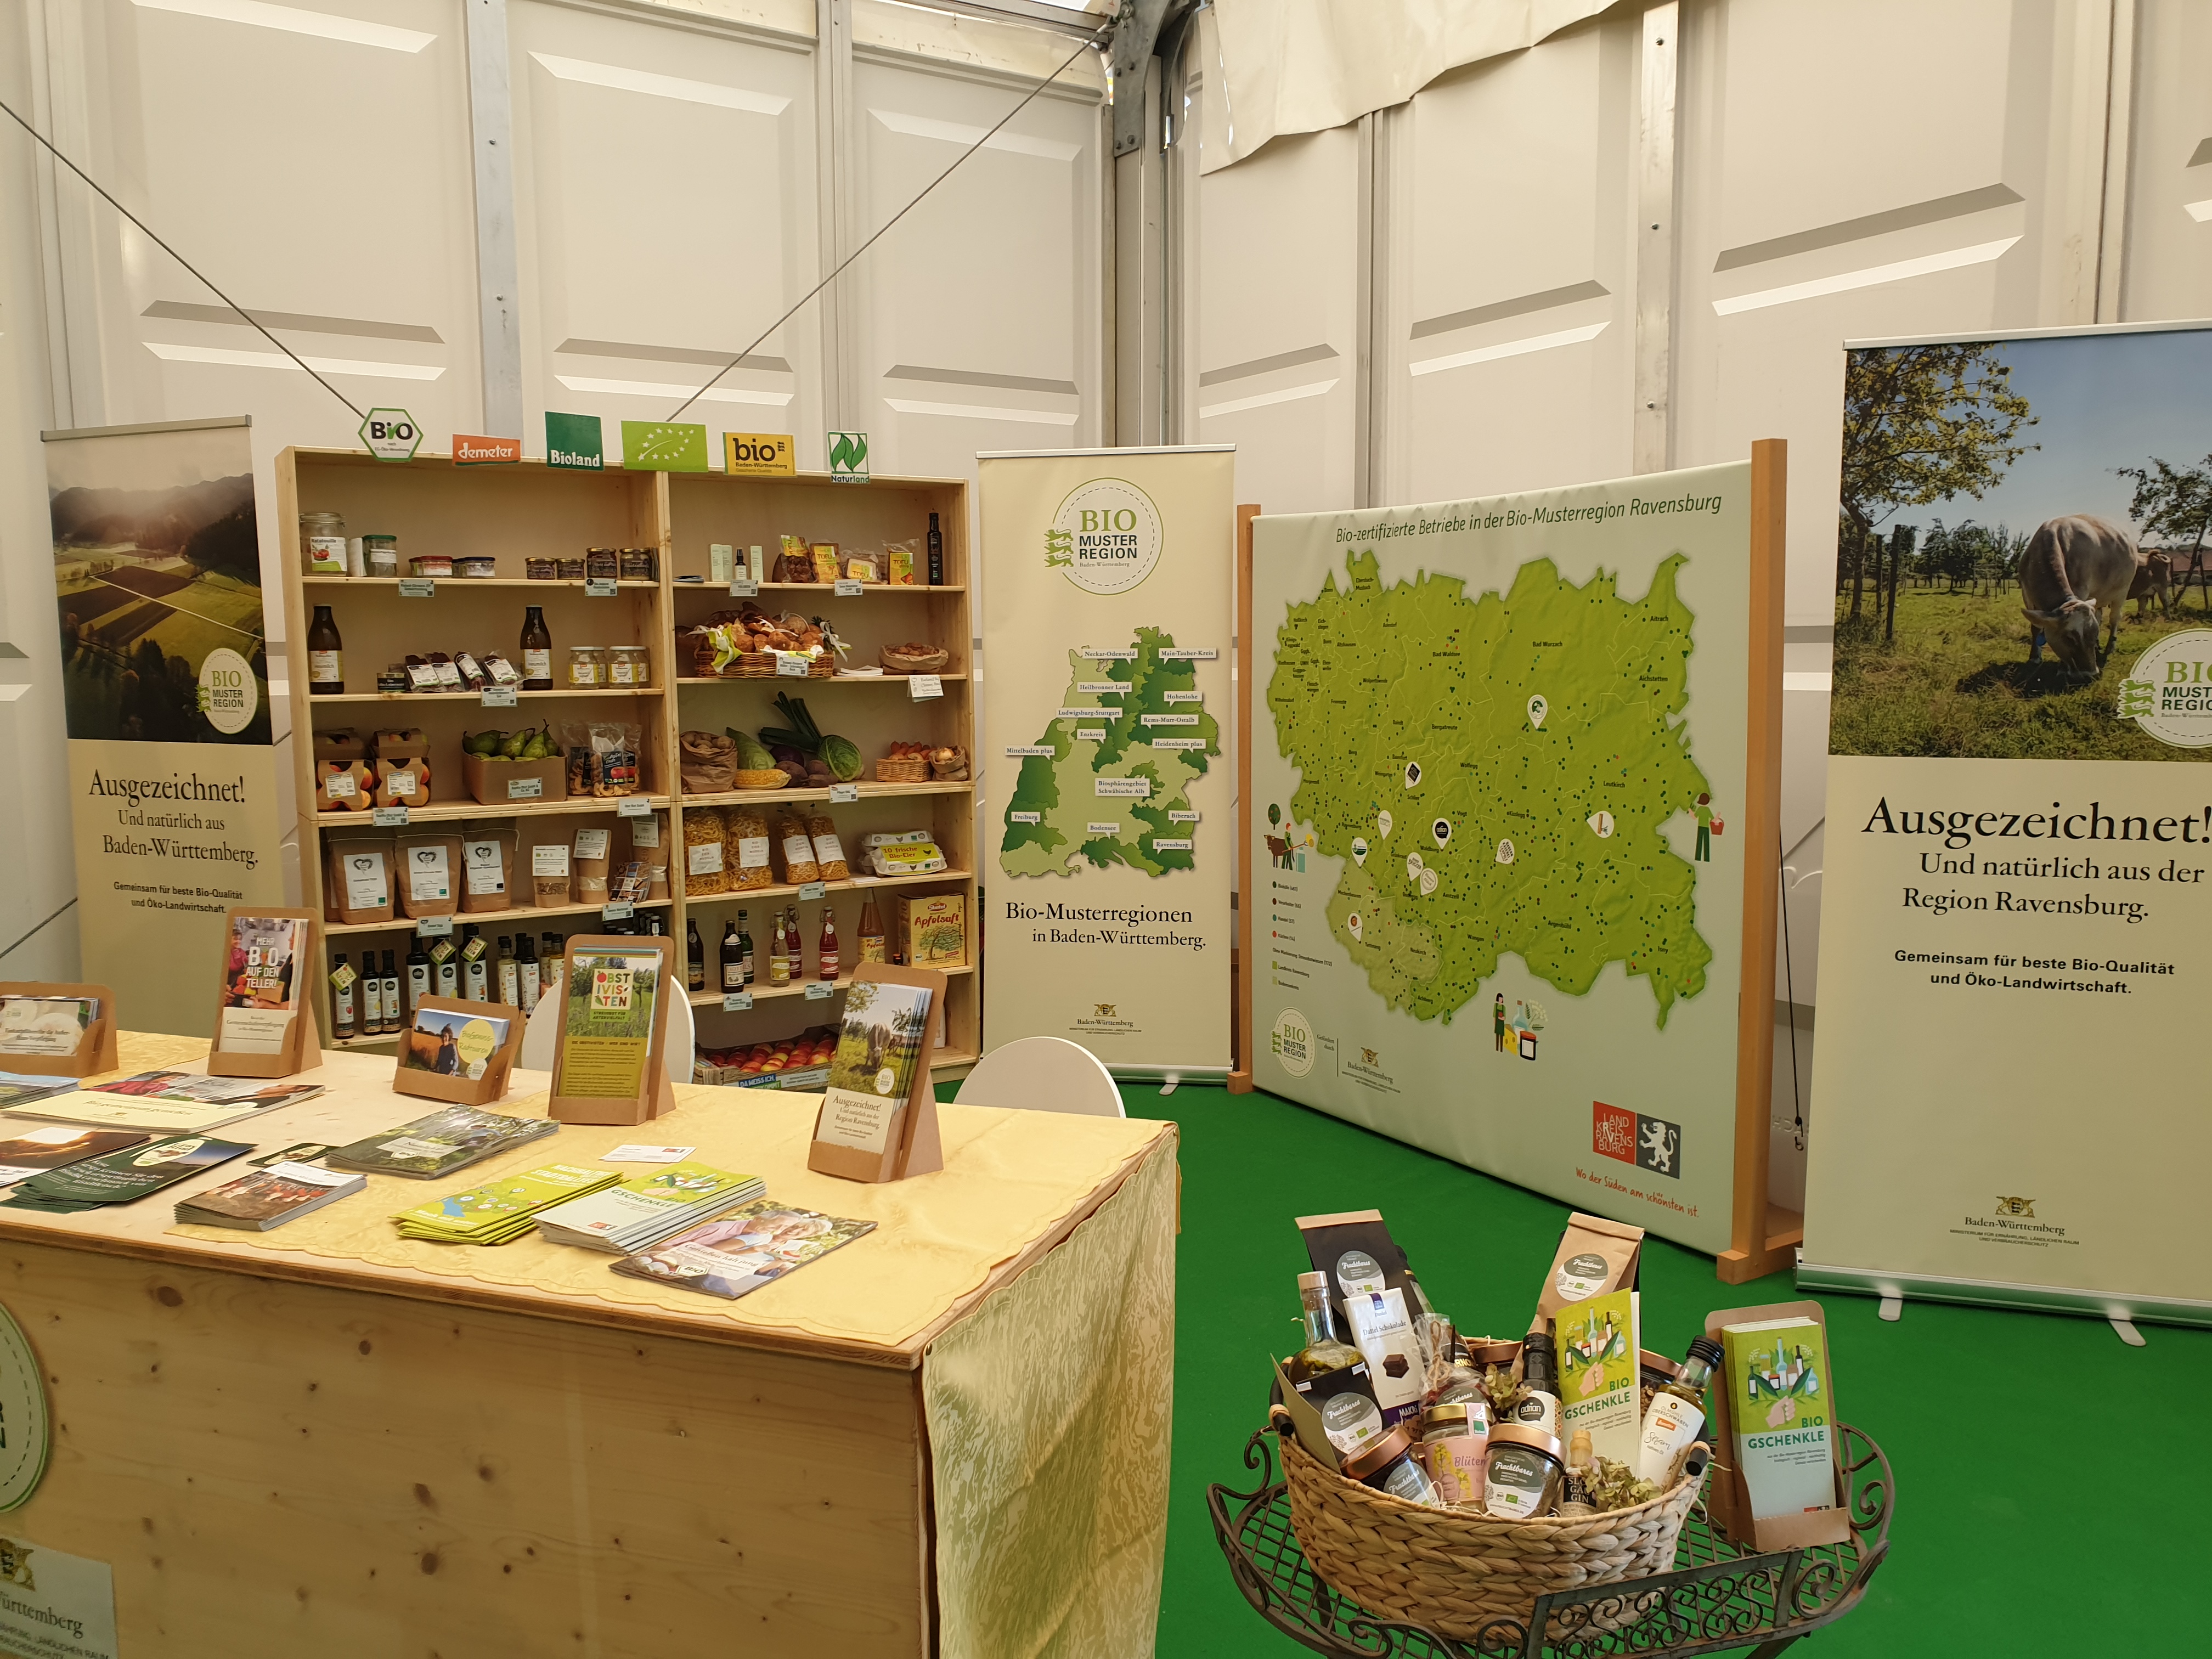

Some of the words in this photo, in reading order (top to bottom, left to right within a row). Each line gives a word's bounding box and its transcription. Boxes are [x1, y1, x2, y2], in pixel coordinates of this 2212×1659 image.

[458, 442, 513, 459] demeter
[733, 437, 776, 461] bio
[550, 450, 600, 467] Bioland
[831, 475, 870, 483] Naturland
[1079, 509, 1137, 532] BIO
[1336, 522, 1415, 543] Bio-zertifizierte
[1419, 516, 1466, 535] Betriebe
[1469, 514, 1481, 530] in
[1484, 511, 1504, 529] der
[1507, 501, 1624, 526] Bio-Musterregion
[1630, 493, 1722, 516] Ravensburg
[1079, 535, 1137, 546] MUSTER
[1079, 548, 1137, 559] REGION
[211, 670, 241, 687] BIO
[212, 690, 243, 698] MUSTER
[89, 768, 245, 807] Ausgezeichnet!
[117, 809, 144, 826] Und
[147, 812, 202, 829] natürlich
[205, 818, 225, 830] aus
[1861, 797, 2211, 849] Ausgezeichnet!
[103, 834, 258, 870] Baden-Württemberg.
[1920, 852, 1976, 875] Und
[1983, 856, 2100, 879] natürlich
[2107, 862, 2150, 881] aus
[2158, 860, 2205, 883] der
[114, 881, 157, 893] Gemeinsam
[159, 884, 170, 894] für
[172, 886, 194, 896] beste
[196, 888, 243, 900] Bio-Qualität
[131, 899, 145, 907] und
[147, 898, 227, 913] Öko-Landwirtschaft.
[1902, 887, 1989, 917] Region
[1994, 890, 2149, 924] Ravensburg.
[915, 913, 960, 929] Apfelsaft
[1005, 902, 1193, 928] Bio-Musterregionen
[256, 937, 275, 946] MEHR
[1032, 928, 1047, 943] in
[1050, 929, 1206, 951] Baden-Württemberg.
[1467, 934, 1485, 942] Wangen
[1658, 946, 1668, 954] Isny
[1894, 950, 1989, 966] Gemeinsam
[1994, 953, 2017, 967] für
[2022, 956, 2067, 970] beste
[2072, 958, 2175, 976] Bio-Qualität
[246, 967, 262, 977] AUF
[263, 968, 279, 978] DEN
[246, 978, 278, 989] TELLER!
[1931, 973, 1961, 985] und
[1965, 971, 2132, 994] Öko-Landwirtschaft.
[603, 996, 627, 1007] TEN
[1077, 1019, 1133, 1028] Baden-Württemberg
[1283, 1024, 1306, 1042] BIO
[1283, 1039, 1306, 1052] MUSTER
[1283, 1046, 1306, 1059] REGION
[1347, 1061, 1393, 1084] Baden-Württemberg
[748, 1077, 764, 1087] WEISS
[833, 1095, 882, 1111] Ausgezeichnet!
[836, 1113, 853, 1124] Region
[853, 1116, 880, 1130] Ravensburg.
[1604, 1113, 1629, 1127] LAND
[1596, 1121, 1624, 1136] KREIS
[1596, 1130, 1633, 1147] RAVENS
[1598, 1139, 1625, 1155] BURG
[611, 1189, 677, 1207] GSCHENKLE
[1576, 1167, 1587, 1179] Wo
[1589, 1172, 1601, 1184] der
[1604, 1176, 1627, 1193] Süden
[1630, 1188, 1644, 1198] am
[1646, 1192, 1684, 1213] schönsten
[1688, 1204, 1699, 1218] ist.
[1965, 1217, 2066, 1237] Baden-Württemberg
[1991, 1238, 2049, 1247] VERBRAUCHERSCHUTZ
[685, 1244, 721, 1259] Genießen
[1341, 1261, 1370, 1269] Fruchtbares
[1573, 1259, 1604, 1270] Fruchtbares
[1363, 1327, 1379, 1336] Dattel
[1379, 1321, 1406, 1332] Schokolade
[1609, 1377, 1629, 1392] BIO
[1327, 1400, 1361, 1420] Fruchtbares
[1521, 1402, 1542, 1413] adrian
[1565, 1391, 1630, 1420] GSCHENKLE
[1652, 1409, 1689, 1427] OBERSCHWABEN
[1802, 1416, 1822, 1428] BIO
[1748, 1430, 1825, 1449] GSCHENKLE
[1495, 1462, 1533, 1477] Fruchtbares
[1571, 1493, 1589, 1503] GIN
